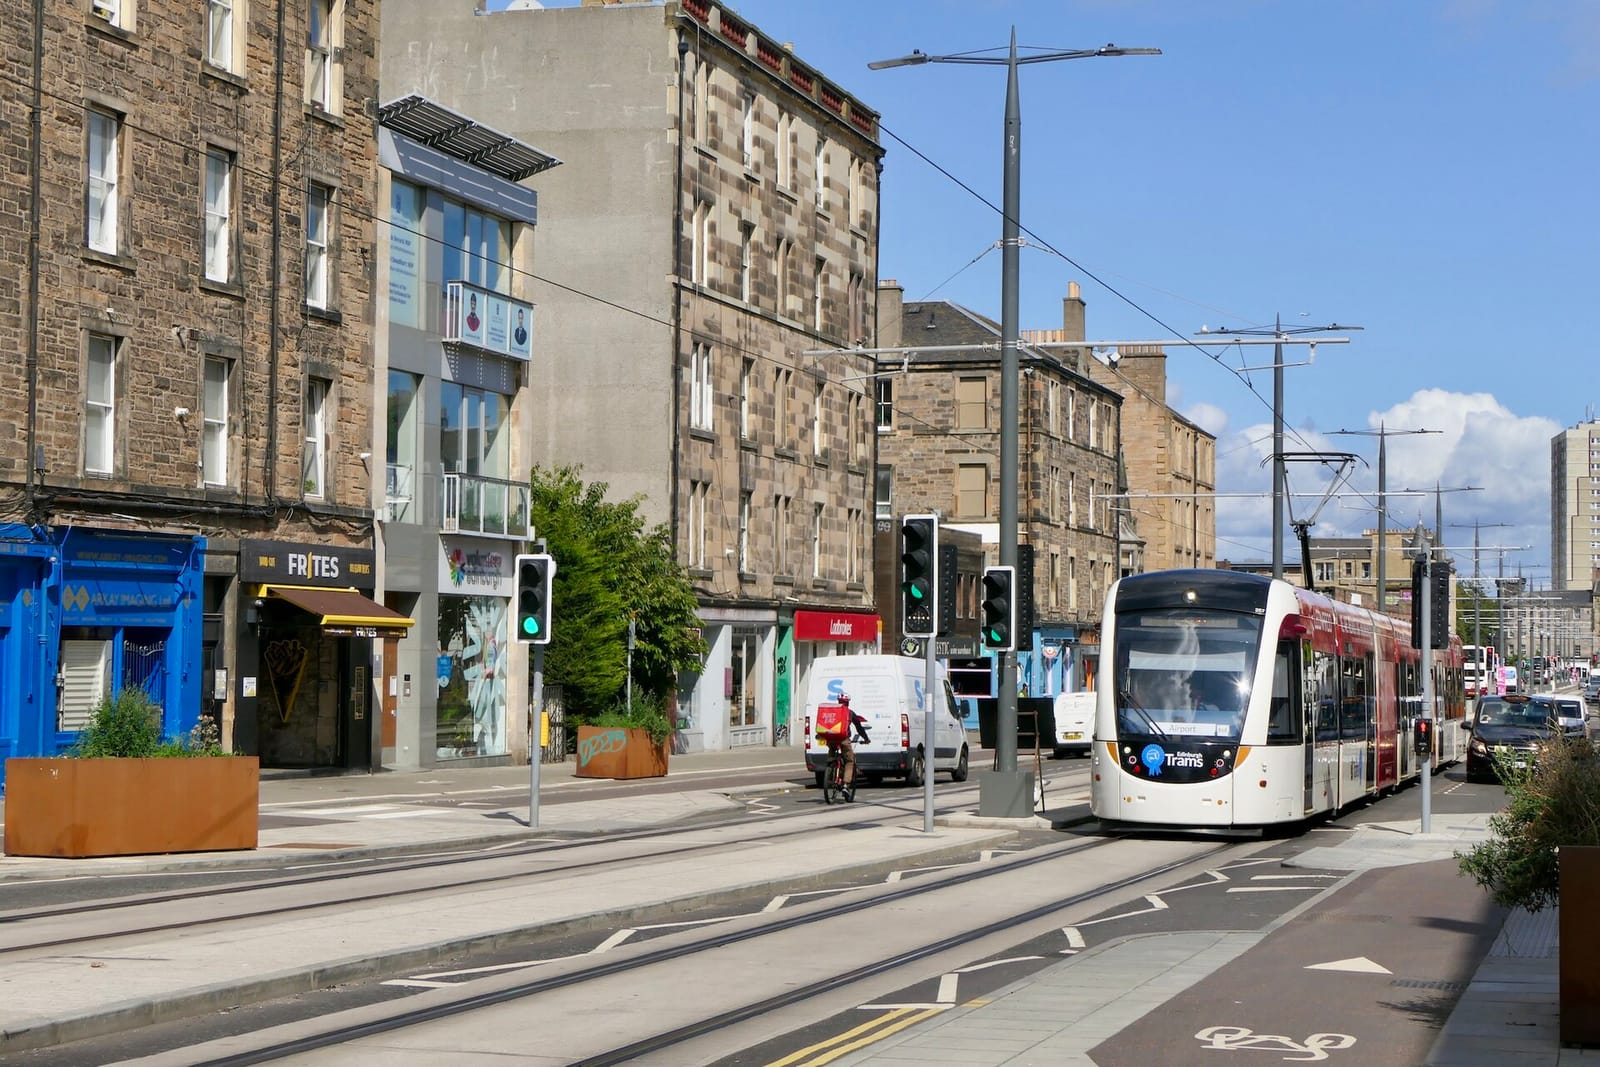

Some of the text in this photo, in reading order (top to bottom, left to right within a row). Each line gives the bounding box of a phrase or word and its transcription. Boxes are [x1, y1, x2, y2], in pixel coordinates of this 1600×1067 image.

[288, 552, 339, 579] FRITES
[356, 627, 377, 637] FRITES
[1169, 724, 1196, 733] Airport
[1165, 753, 1204, 767] Trams
[1177, 751, 1203, 759] Edinburgh
